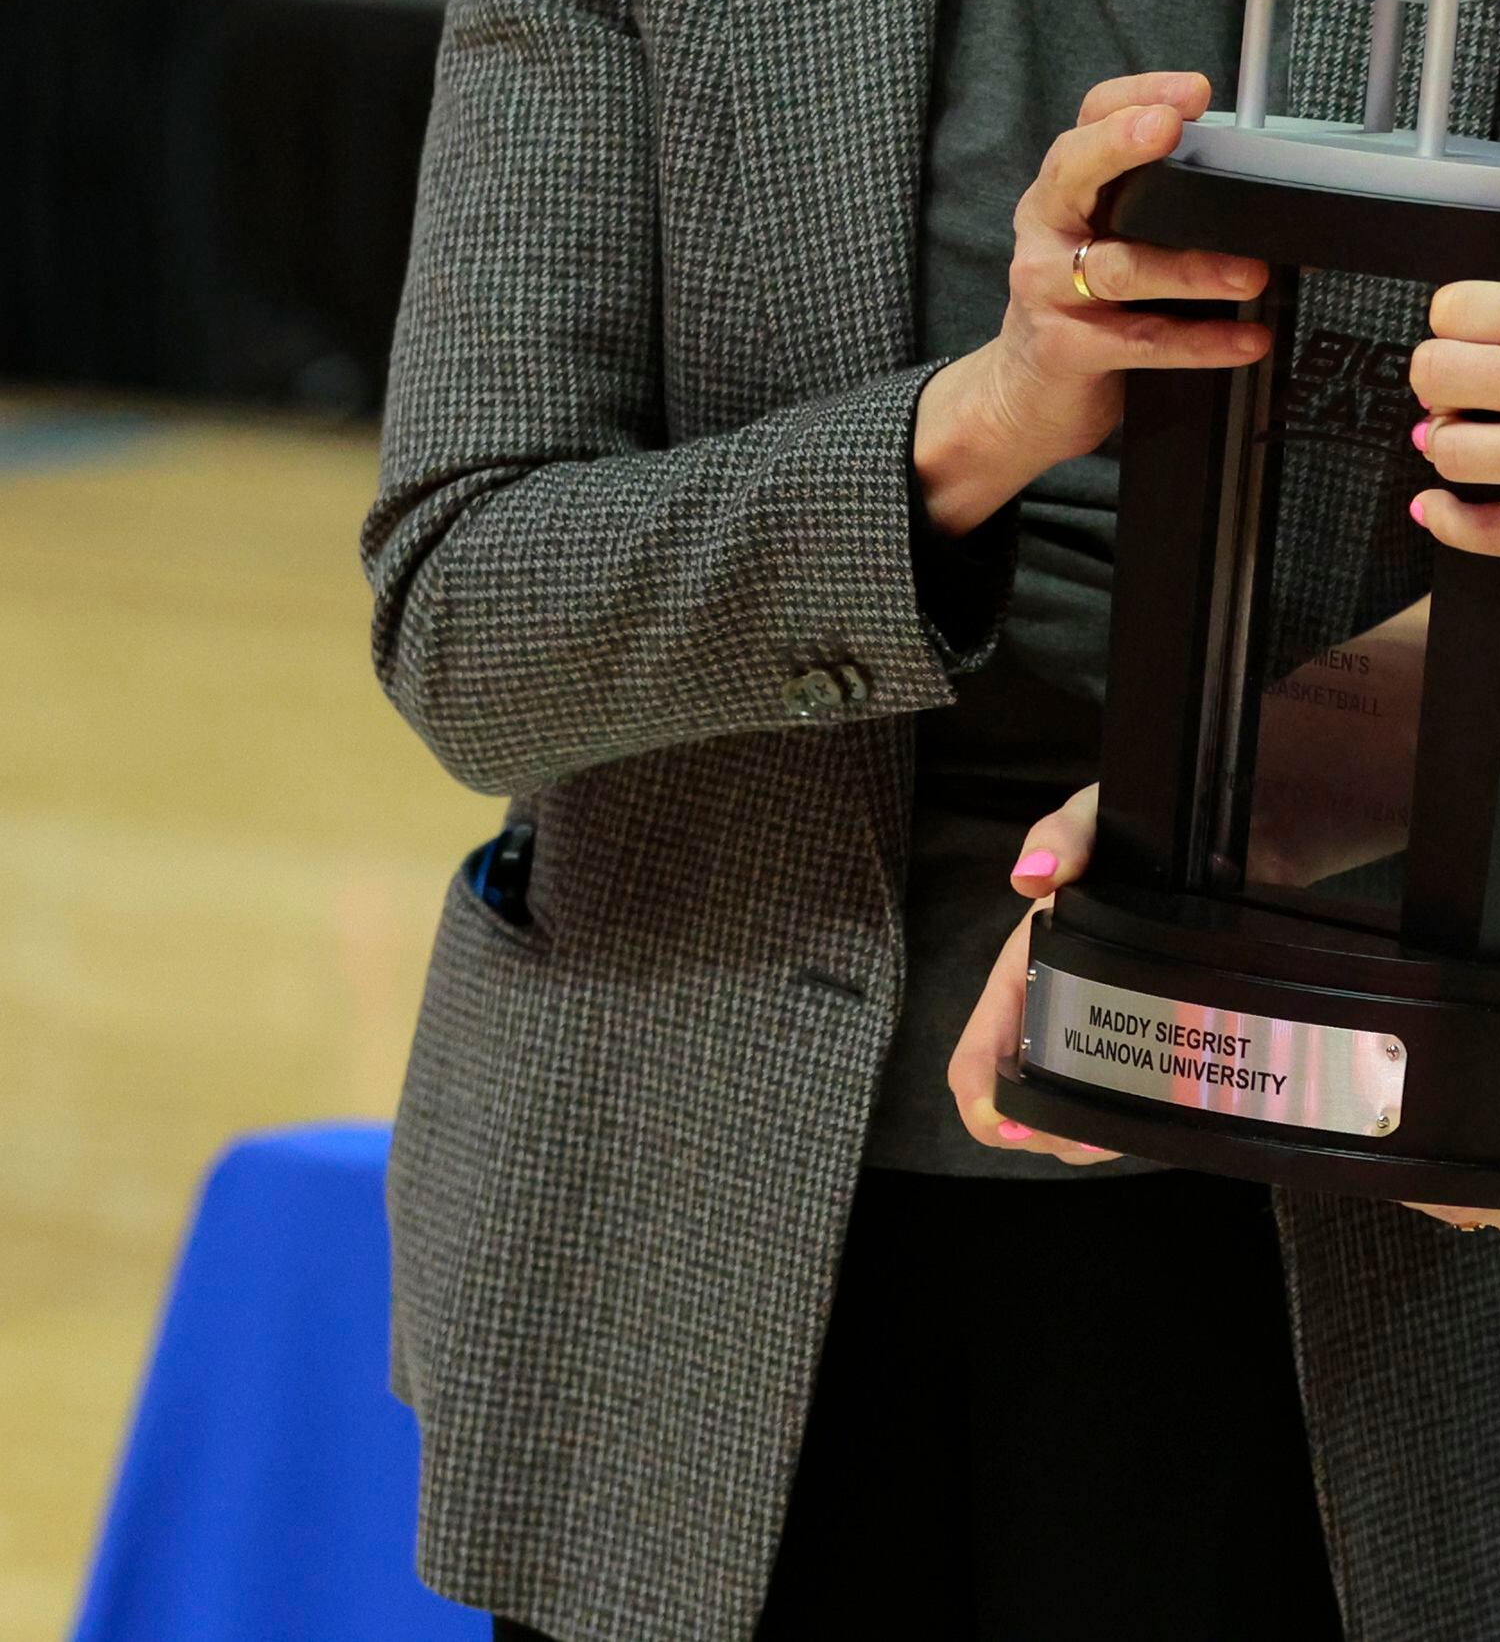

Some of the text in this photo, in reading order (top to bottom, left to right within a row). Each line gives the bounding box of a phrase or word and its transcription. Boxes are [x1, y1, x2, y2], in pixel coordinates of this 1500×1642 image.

[1065, 1027, 1288, 1096] VILLANOVA UNIVERSITY
[1089, 1005, 1252, 1059] MADDY SIEGRIST
